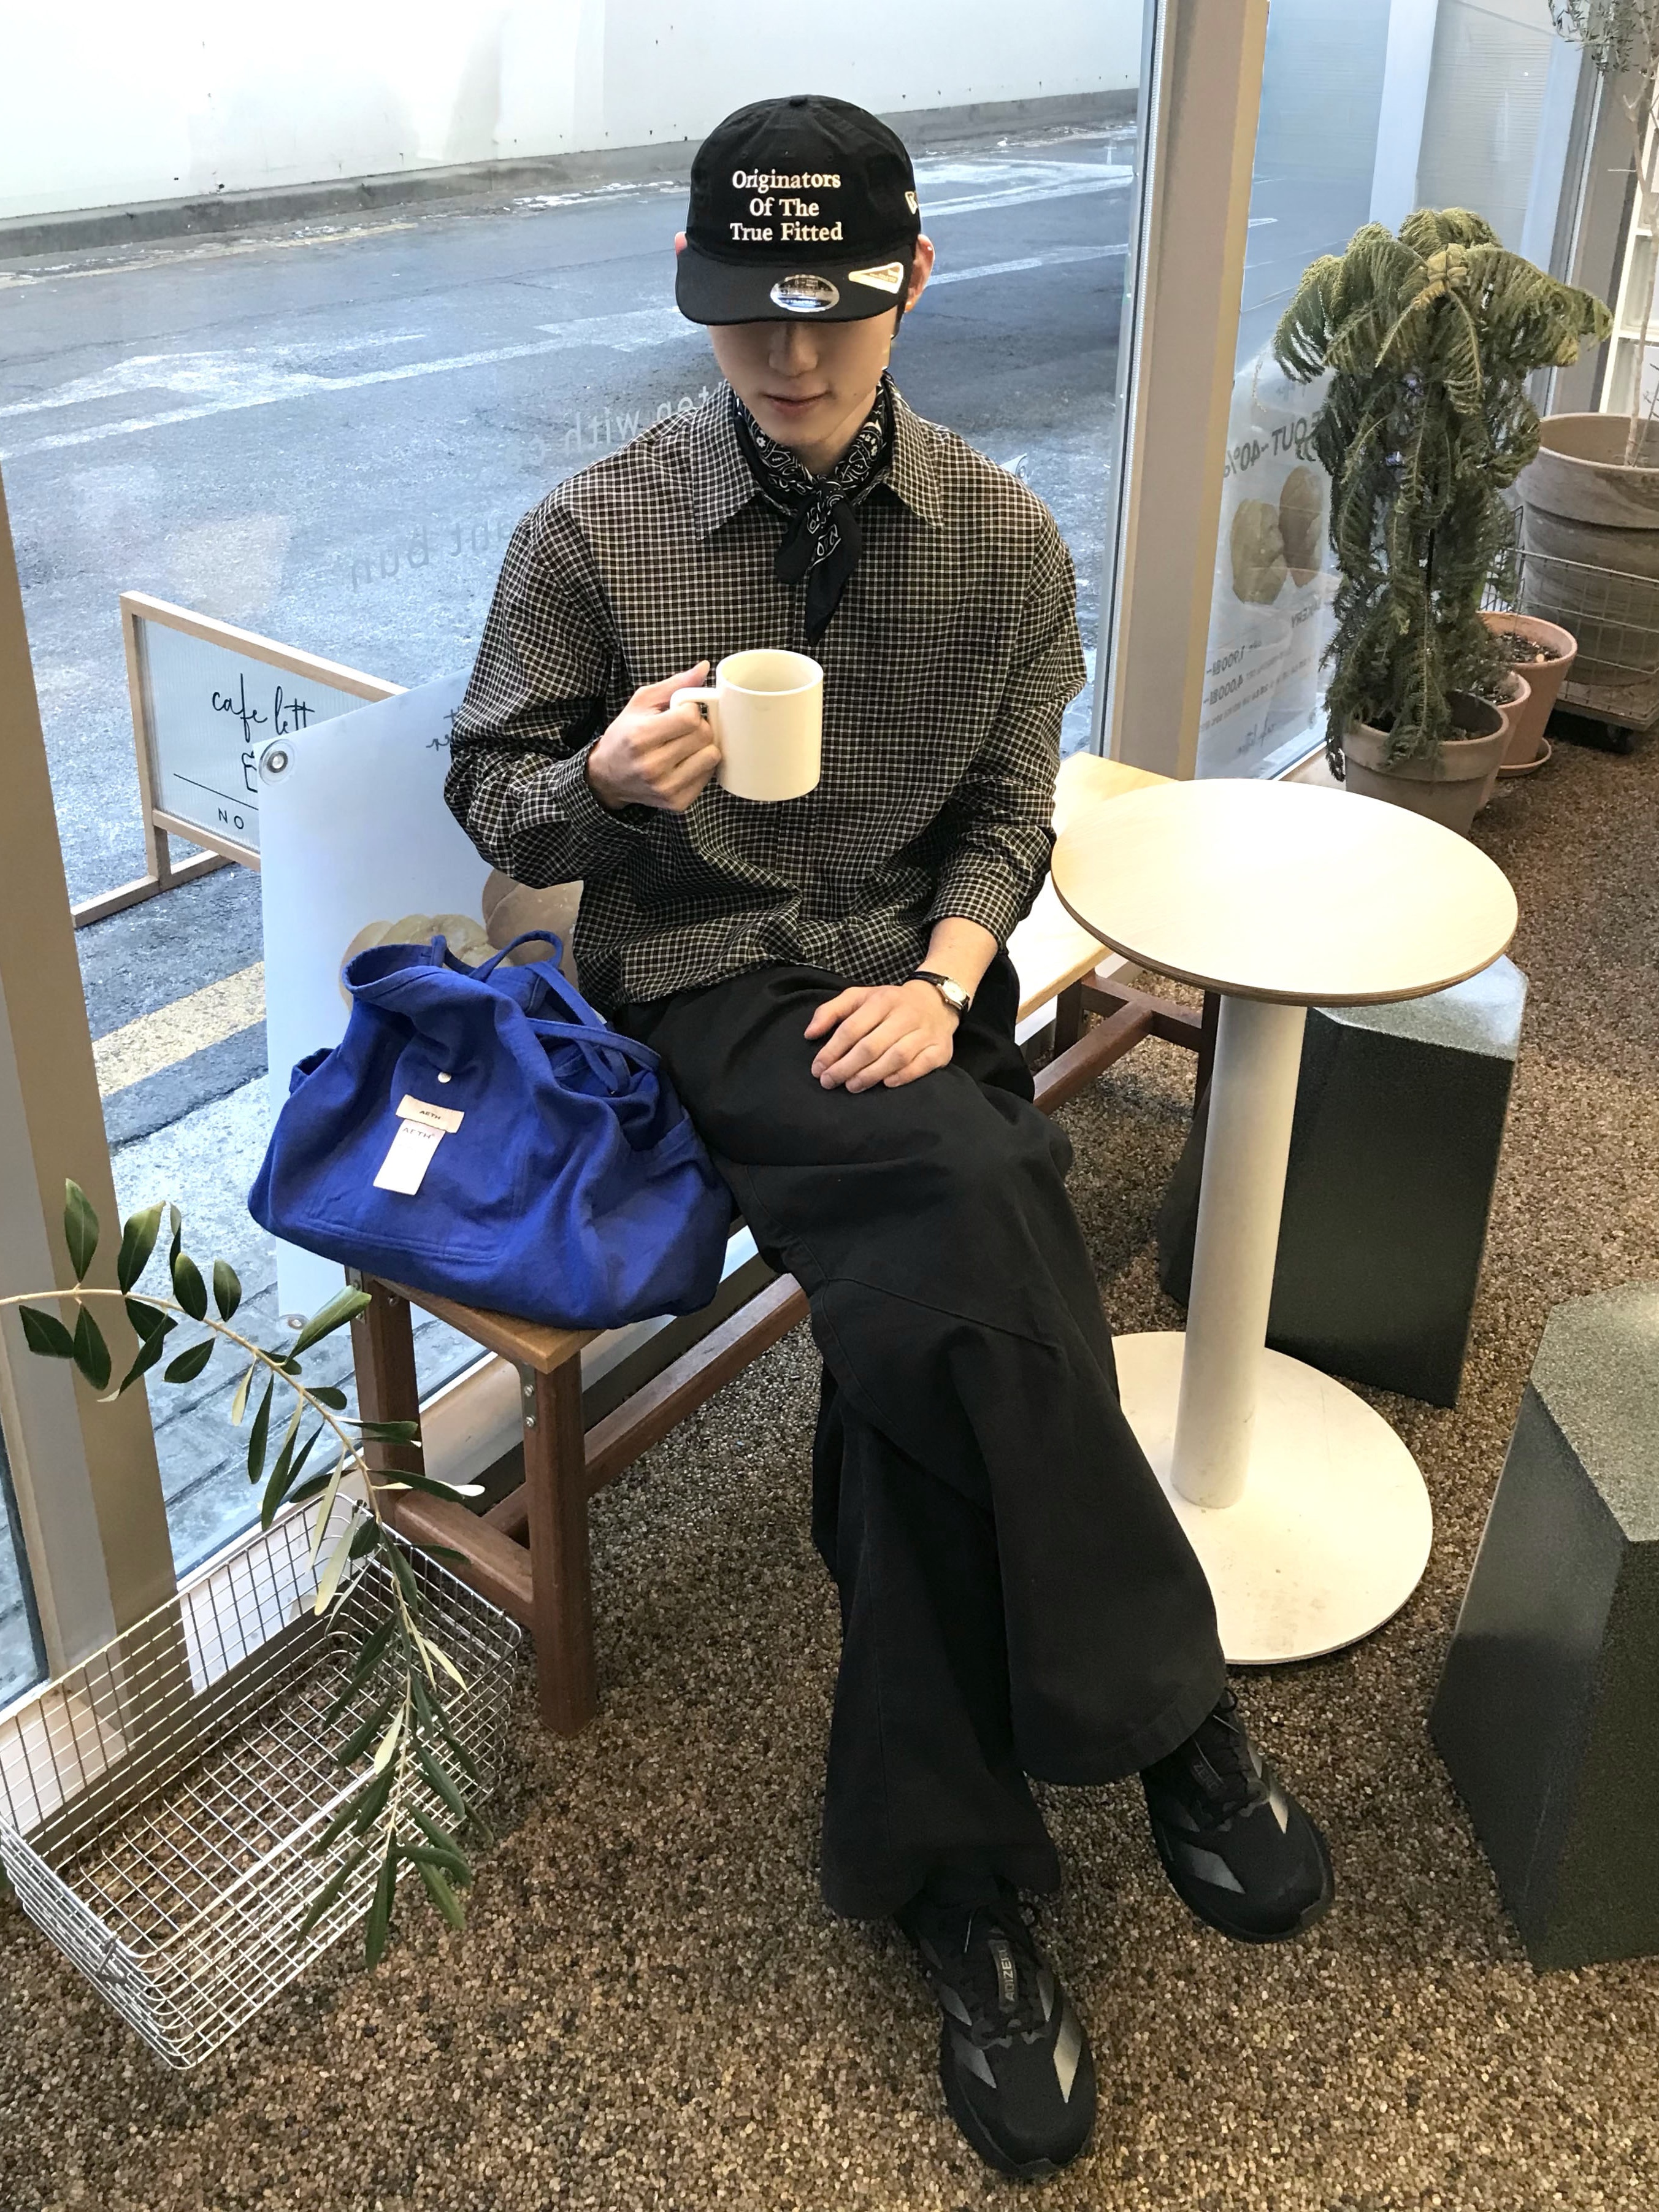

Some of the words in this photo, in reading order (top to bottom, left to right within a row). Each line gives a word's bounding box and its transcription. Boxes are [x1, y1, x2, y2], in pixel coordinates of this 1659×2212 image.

[732, 168, 841, 194] Originators
[749, 197, 775, 217] Of
[779, 198, 819, 217] The
[730, 222, 773, 242] True
[780, 221, 843, 242] Fitted
[212, 672, 268, 743] cafe
[419, 1110, 441, 1119] AETH
